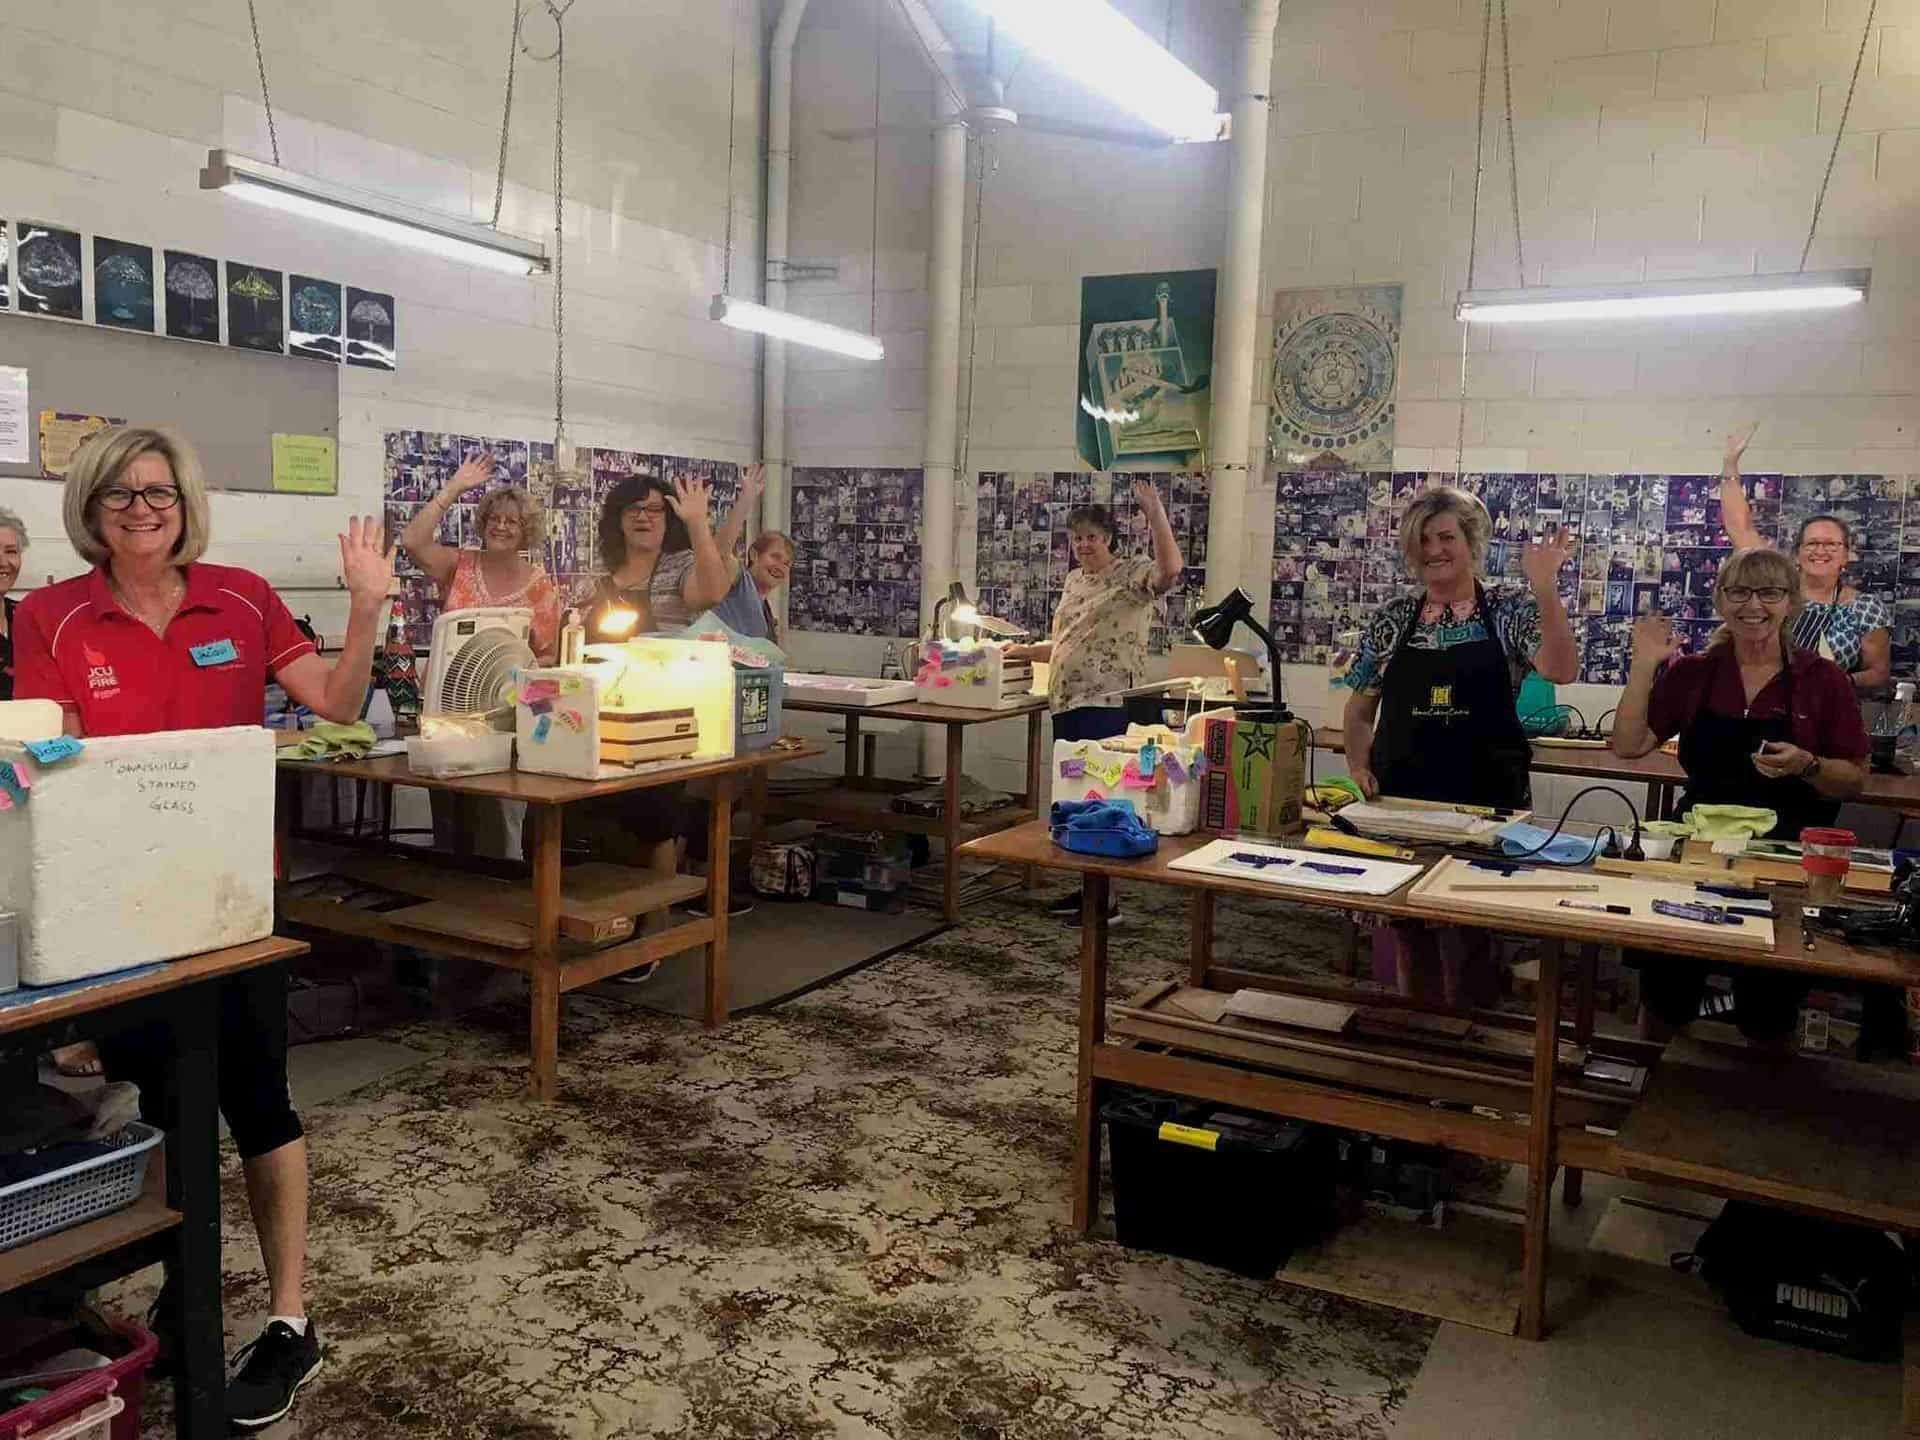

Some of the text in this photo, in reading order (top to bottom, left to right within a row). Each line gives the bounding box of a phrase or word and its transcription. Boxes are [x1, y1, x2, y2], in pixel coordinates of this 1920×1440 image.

[87, 665, 114, 678] JCU
[88, 677, 119, 689] FIRE
[136, 776, 196, 793] STAINED
[148, 795, 194, 815] GLASS
